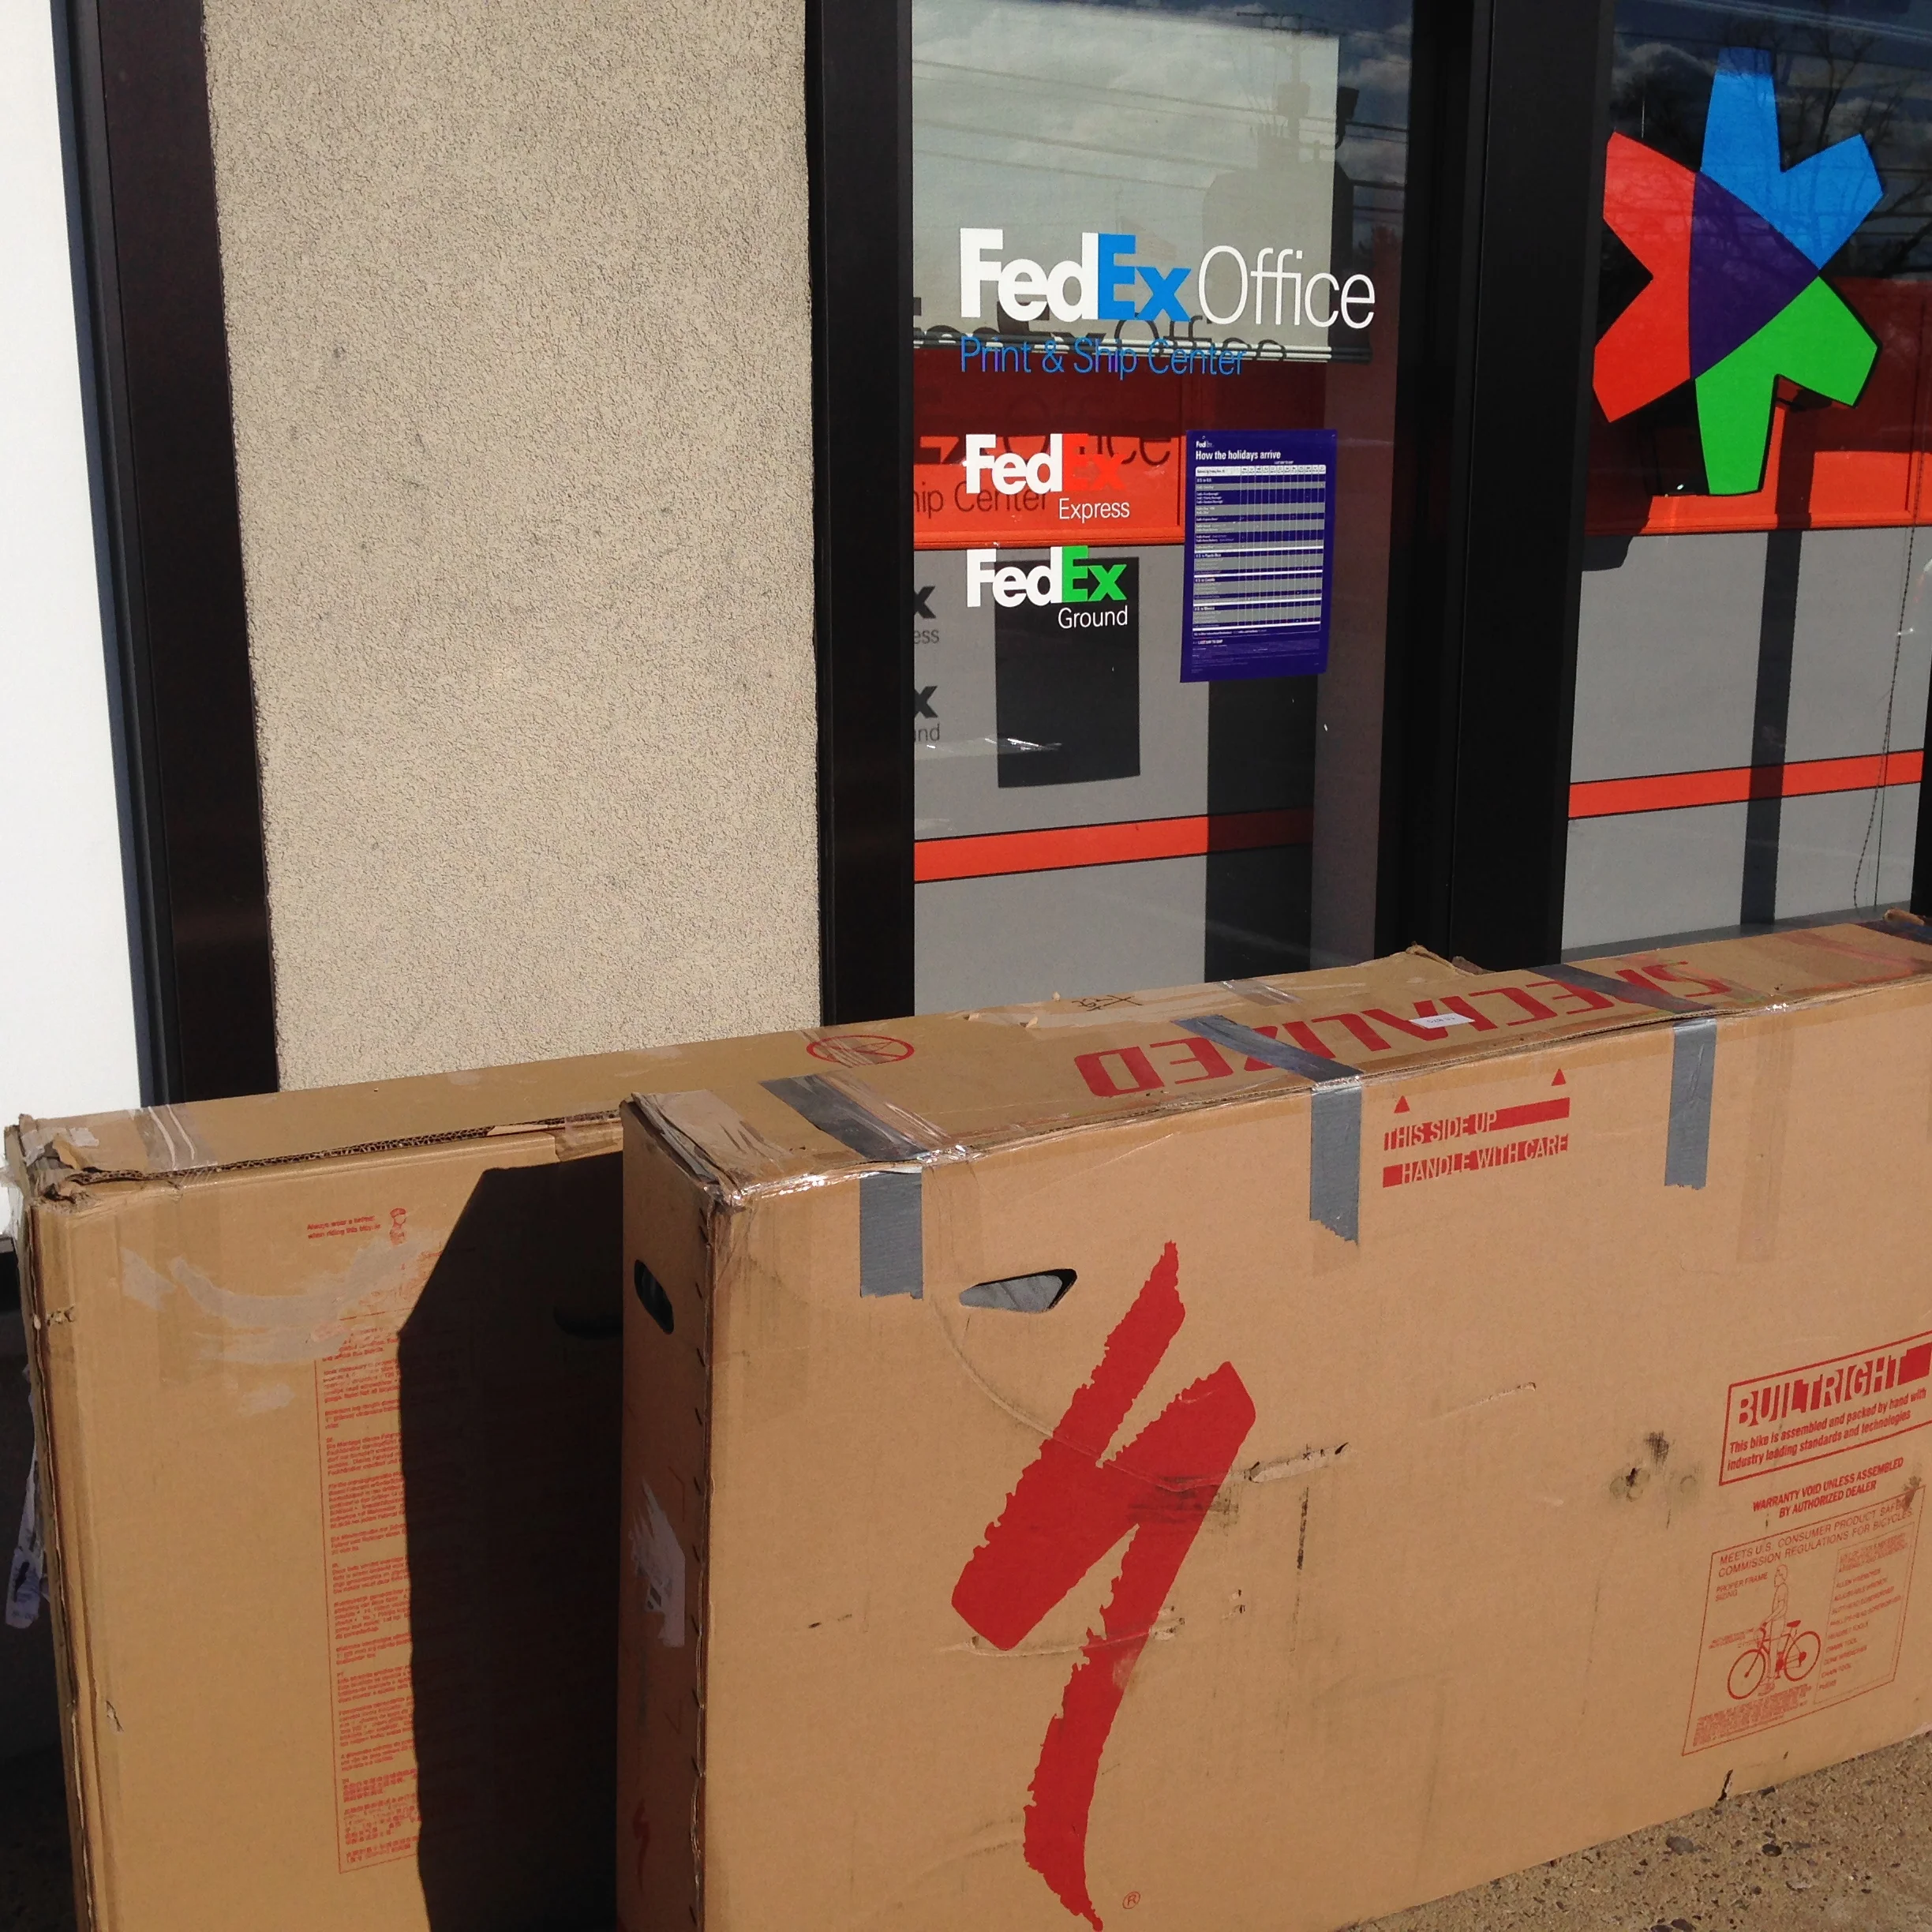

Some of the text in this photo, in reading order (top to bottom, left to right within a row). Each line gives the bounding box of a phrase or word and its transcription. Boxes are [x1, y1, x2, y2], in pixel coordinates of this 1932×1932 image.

[960, 228, 1191, 322] FedEx
[1198, 245, 1376, 329] Office
[960, 335, 1246, 380] Print & Ship Center
[965, 433, 1125, 495] FedEx
[1196, 449, 1281, 461] How the holidays arrive
[1059, 498, 1130, 523] Express
[967, 545, 1127, 608] FedEx
[1058, 605, 1128, 629] Ground
[1383, 1110, 1498, 1151] THIS SIDE UP
[1402, 1133, 1569, 1184] HANDLE WITH CARE
[1736, 1353, 1907, 1427] BUILTRIGHT
[1728, 1410, 1911, 1471] industry leading standards and technologies
[1729, 1387, 1926, 1455] This bike is assembled and packed by hand with
[1752, 1457, 1904, 1512] WARRANTY VOID UNLESS ASSEMBLED
[1779, 1480, 1878, 1518] BY AUTHORIZED DEALER
[1718, 1552, 1781, 1578] COMMISSION
[1784, 1531, 1849, 1559] REGULATIONS
[1852, 1523, 1870, 1537] FOR
[1873, 1510, 1912, 1531] BICYCLES
[1720, 1548, 1753, 1565] MEETS
[1778, 1524, 1831, 1548] CONSUMER
[1834, 1510, 1876, 1531] PRODUCT
[1880, 1496, 1912, 1517] SAFE
